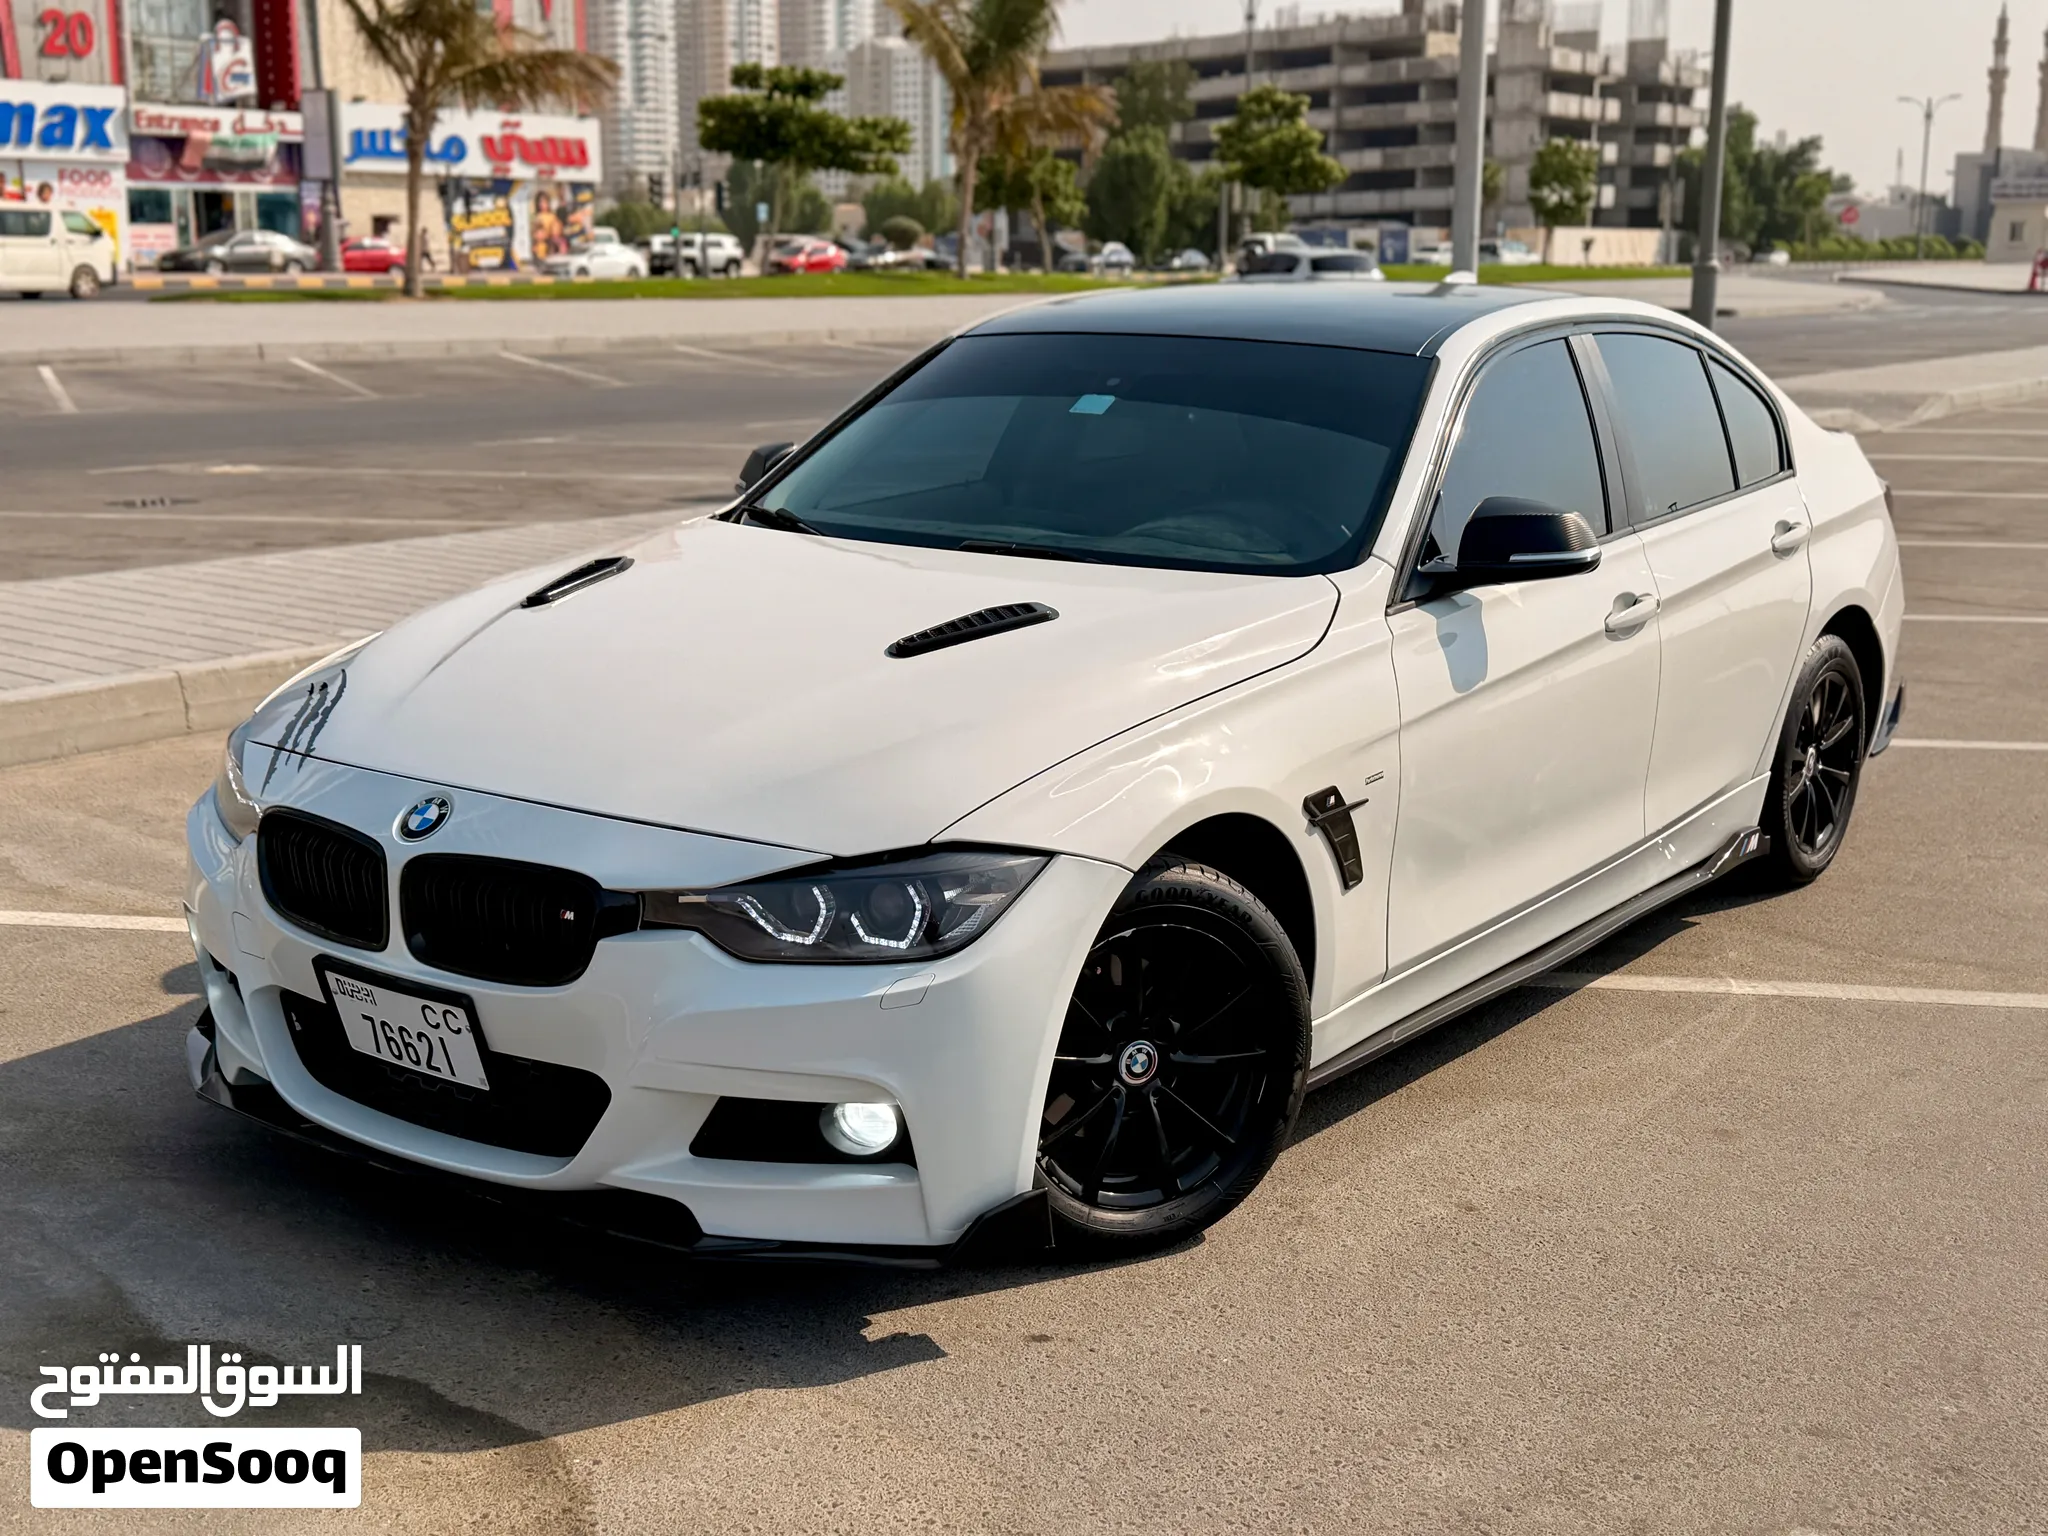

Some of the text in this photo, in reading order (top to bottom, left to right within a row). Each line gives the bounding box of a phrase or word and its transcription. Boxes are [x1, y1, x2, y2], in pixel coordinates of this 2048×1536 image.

[41, 8, 95, 59] 20
[134, 109, 221, 133] Entrance
[480, 119, 590, 177] سيتي
[361, 1013, 457, 1077] 76621
[421, 1004, 462, 1035] CC
